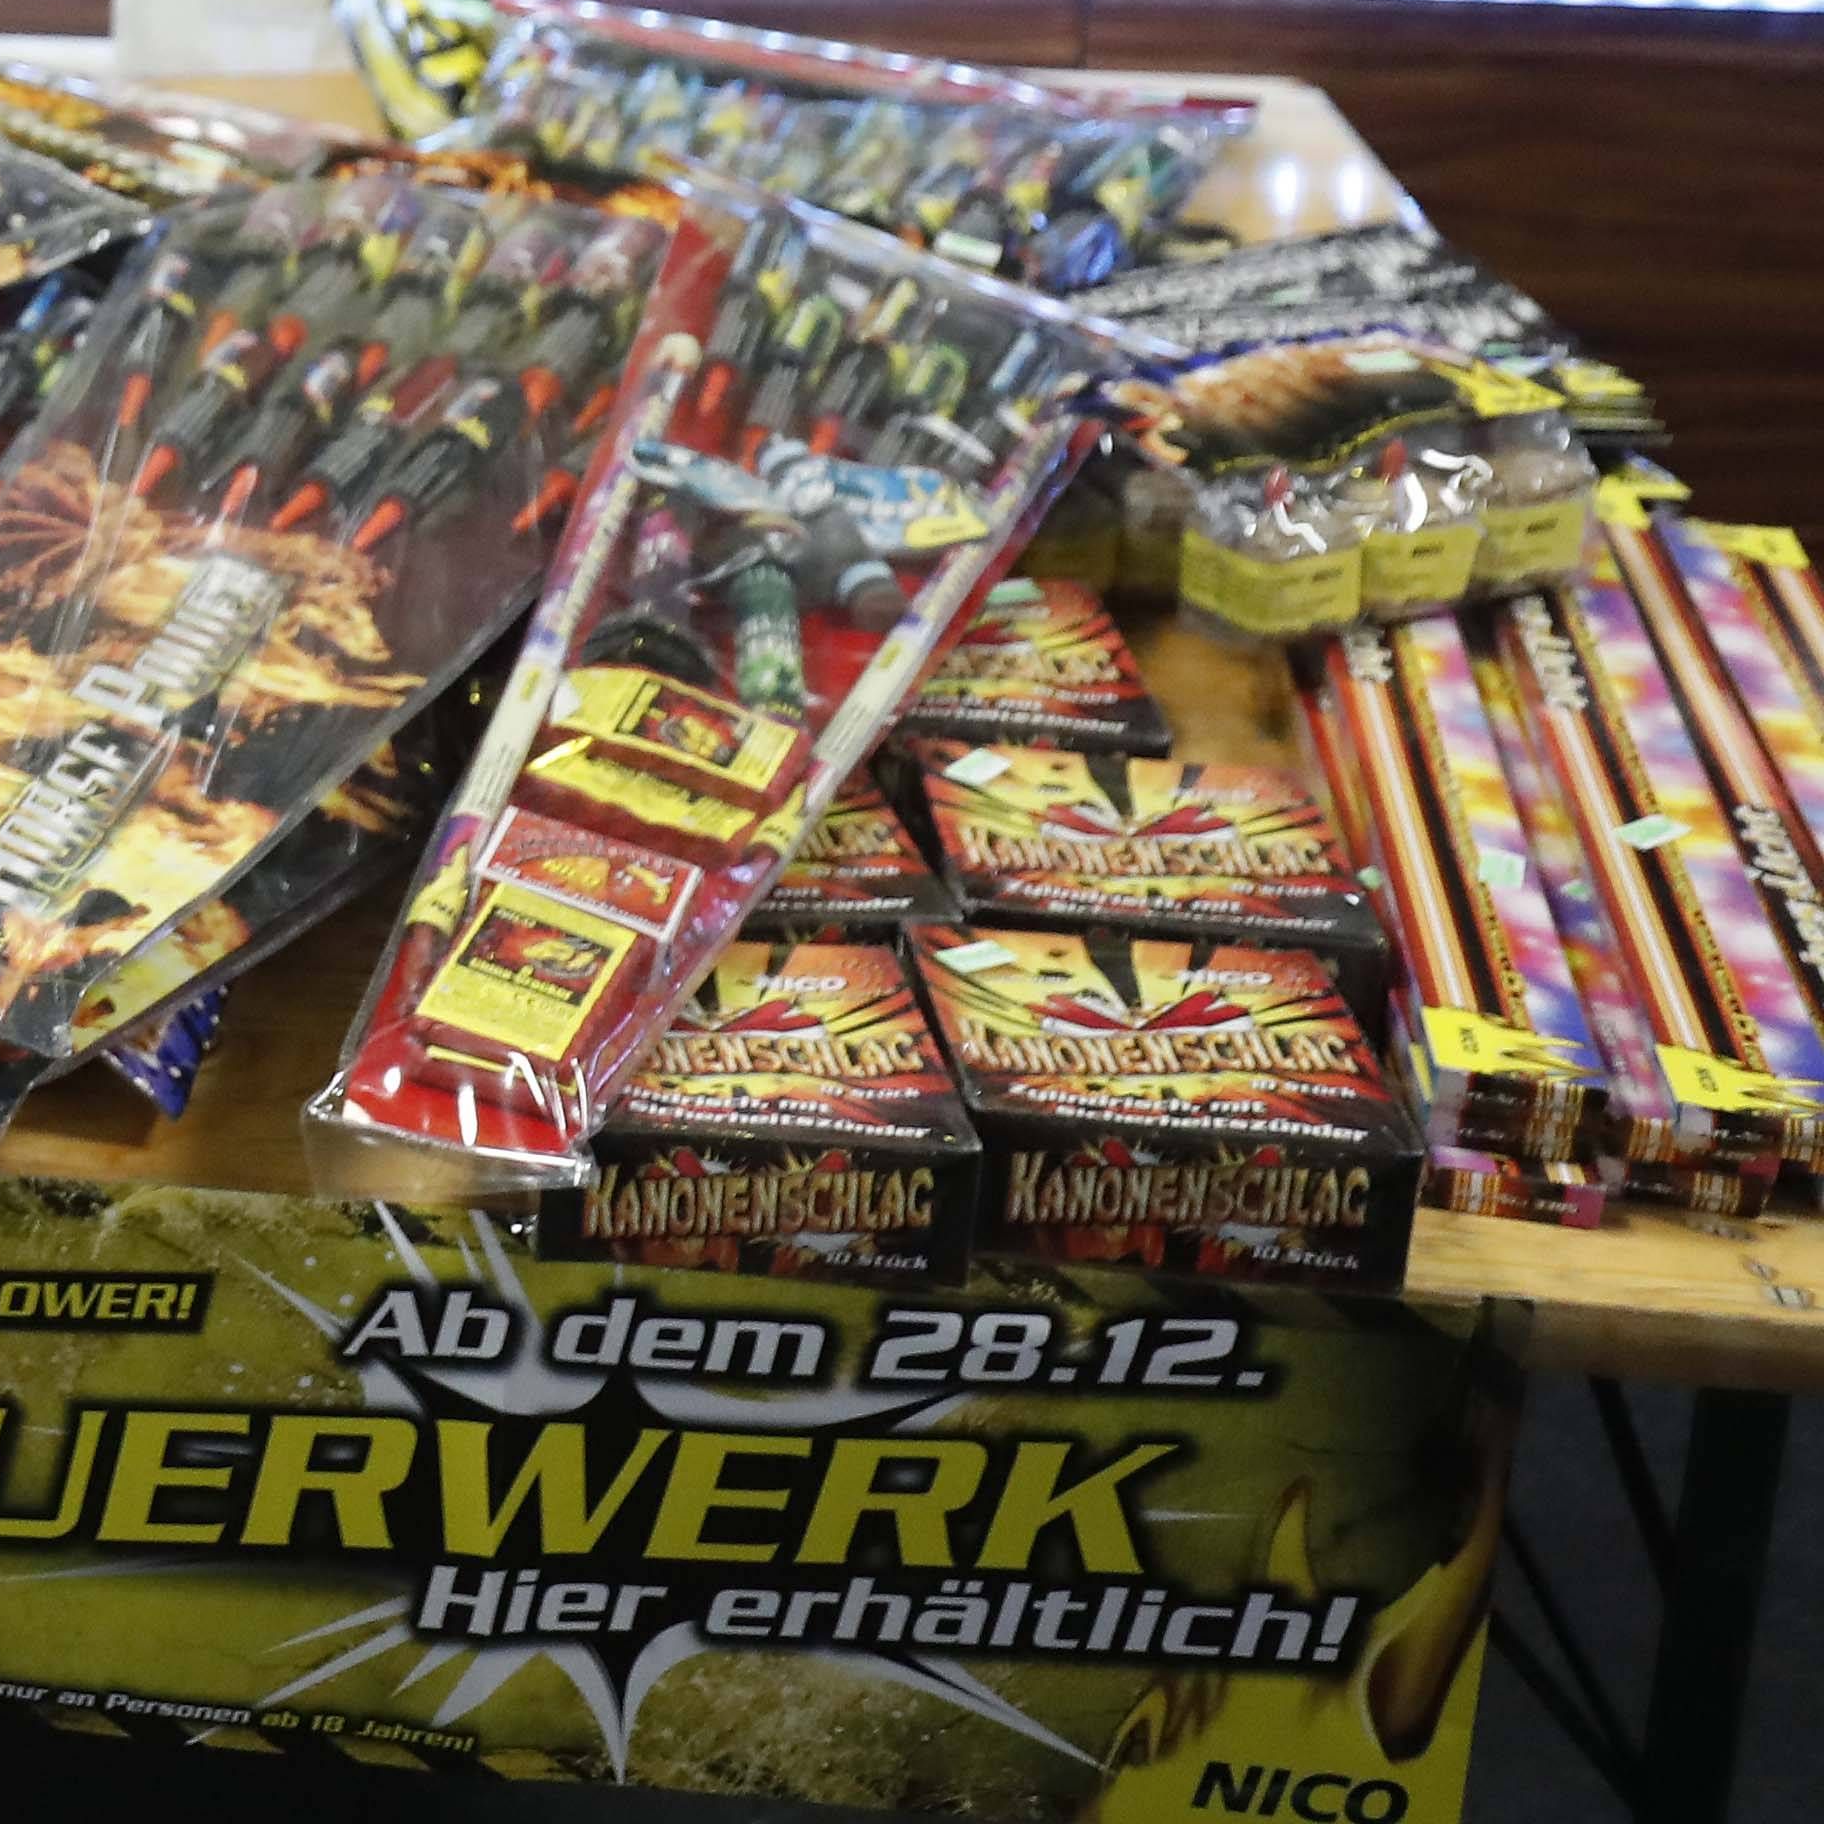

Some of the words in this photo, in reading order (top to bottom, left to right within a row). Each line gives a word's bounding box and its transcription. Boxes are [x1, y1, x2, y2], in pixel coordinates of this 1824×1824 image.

[652, 1030, 924, 1078] NENSCHLAG
[957, 1017, 1359, 1076] KANONENSCHLAG
[583, 1164, 935, 1239] KANONENSCHLAG
[1007, 1151, 1371, 1227] KANONENSCHLAG
[344, 1289, 512, 1360] Ab
[555, 1298, 826, 1377] dem
[870, 1308, 1268, 1388] 28.12.
[417, 1564, 668, 1639] Hier
[704, 1574, 1358, 1663] erhältlich!
[58, 1689, 97, 1710] an
[104, 1691, 251, 1728] Personen
[311, 1713, 346, 1735] 18
[355, 1717, 476, 1755] Jahren!
[1191, 1761, 1410, 1824] NICO
